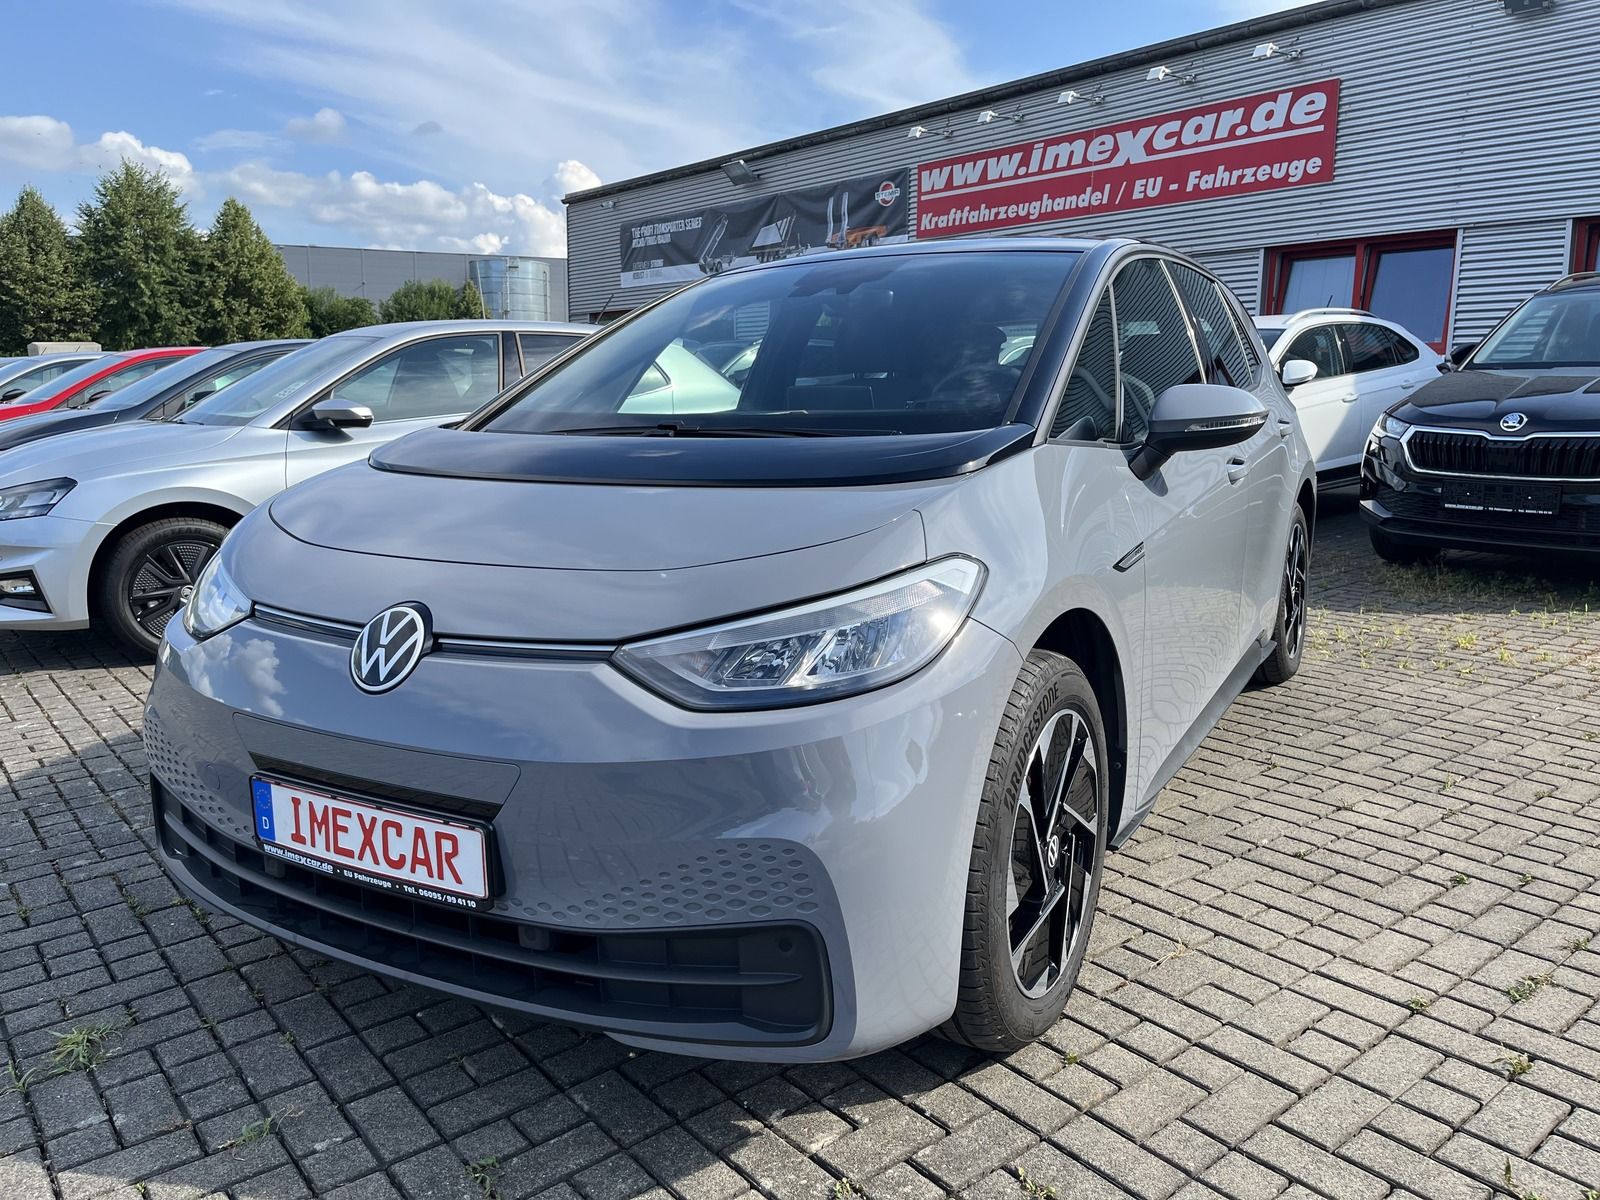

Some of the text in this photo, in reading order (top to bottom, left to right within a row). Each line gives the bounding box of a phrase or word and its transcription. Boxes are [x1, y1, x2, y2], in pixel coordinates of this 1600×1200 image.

[921, 90, 1327, 193] www.imexcar.de
[685, 216, 703, 230] SERIES
[920, 184, 1109, 231] Kraftfahrzeughandel
[1132, 178, 1162, 201] EU
[1186, 156, 1323, 193] Fahrzeuge
[1004, 681, 1060, 815] BRIDGESTONE
[262, 816, 270, 830] D
[291, 796, 463, 885] IMEXCAR
[263, 843, 334, 873] www.imexcar.de
[343, 870, 353, 878] EU
[354, 872, 392, 888] Fahrzeuge
